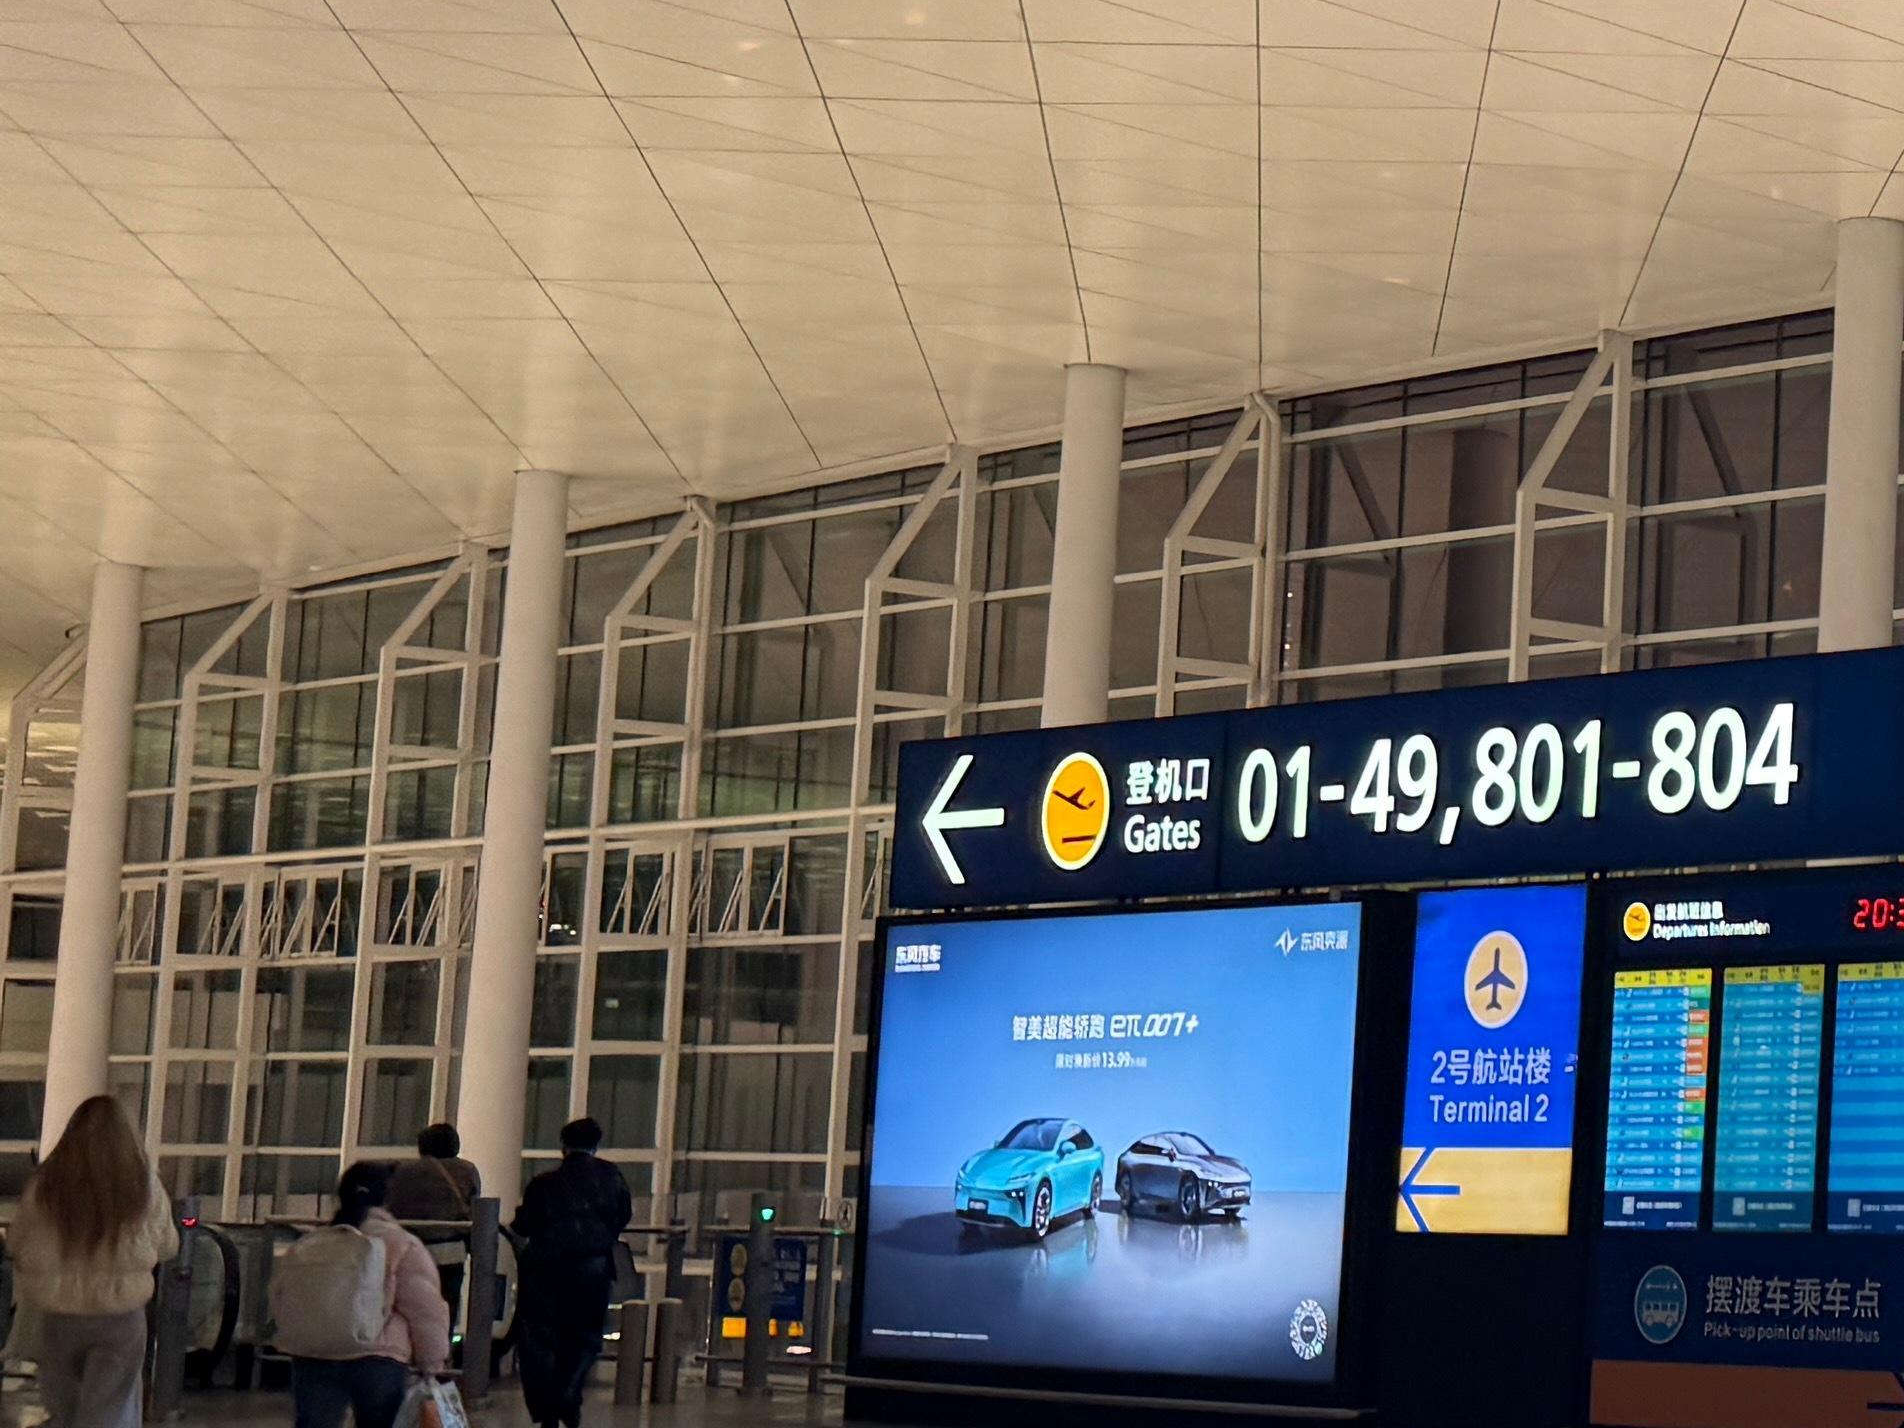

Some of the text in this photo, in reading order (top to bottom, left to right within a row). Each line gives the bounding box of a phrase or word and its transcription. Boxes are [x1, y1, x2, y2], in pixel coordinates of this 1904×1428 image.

[1126, 758, 1210, 805] 登机口
[1239, 703, 1798, 845] 01-49,801-804
[1125, 815, 1200, 853] Gates
[1652, 919, 1770, 941] Departures Information
[1431, 1047, 1551, 1085] 2号航站楼
[1429, 1093, 1549, 1123] Terminal 2
[1706, 1274, 1881, 1318] 摆渡车乘车点
[1704, 1321, 1880, 1343] Pick-up point of shuttle bus
